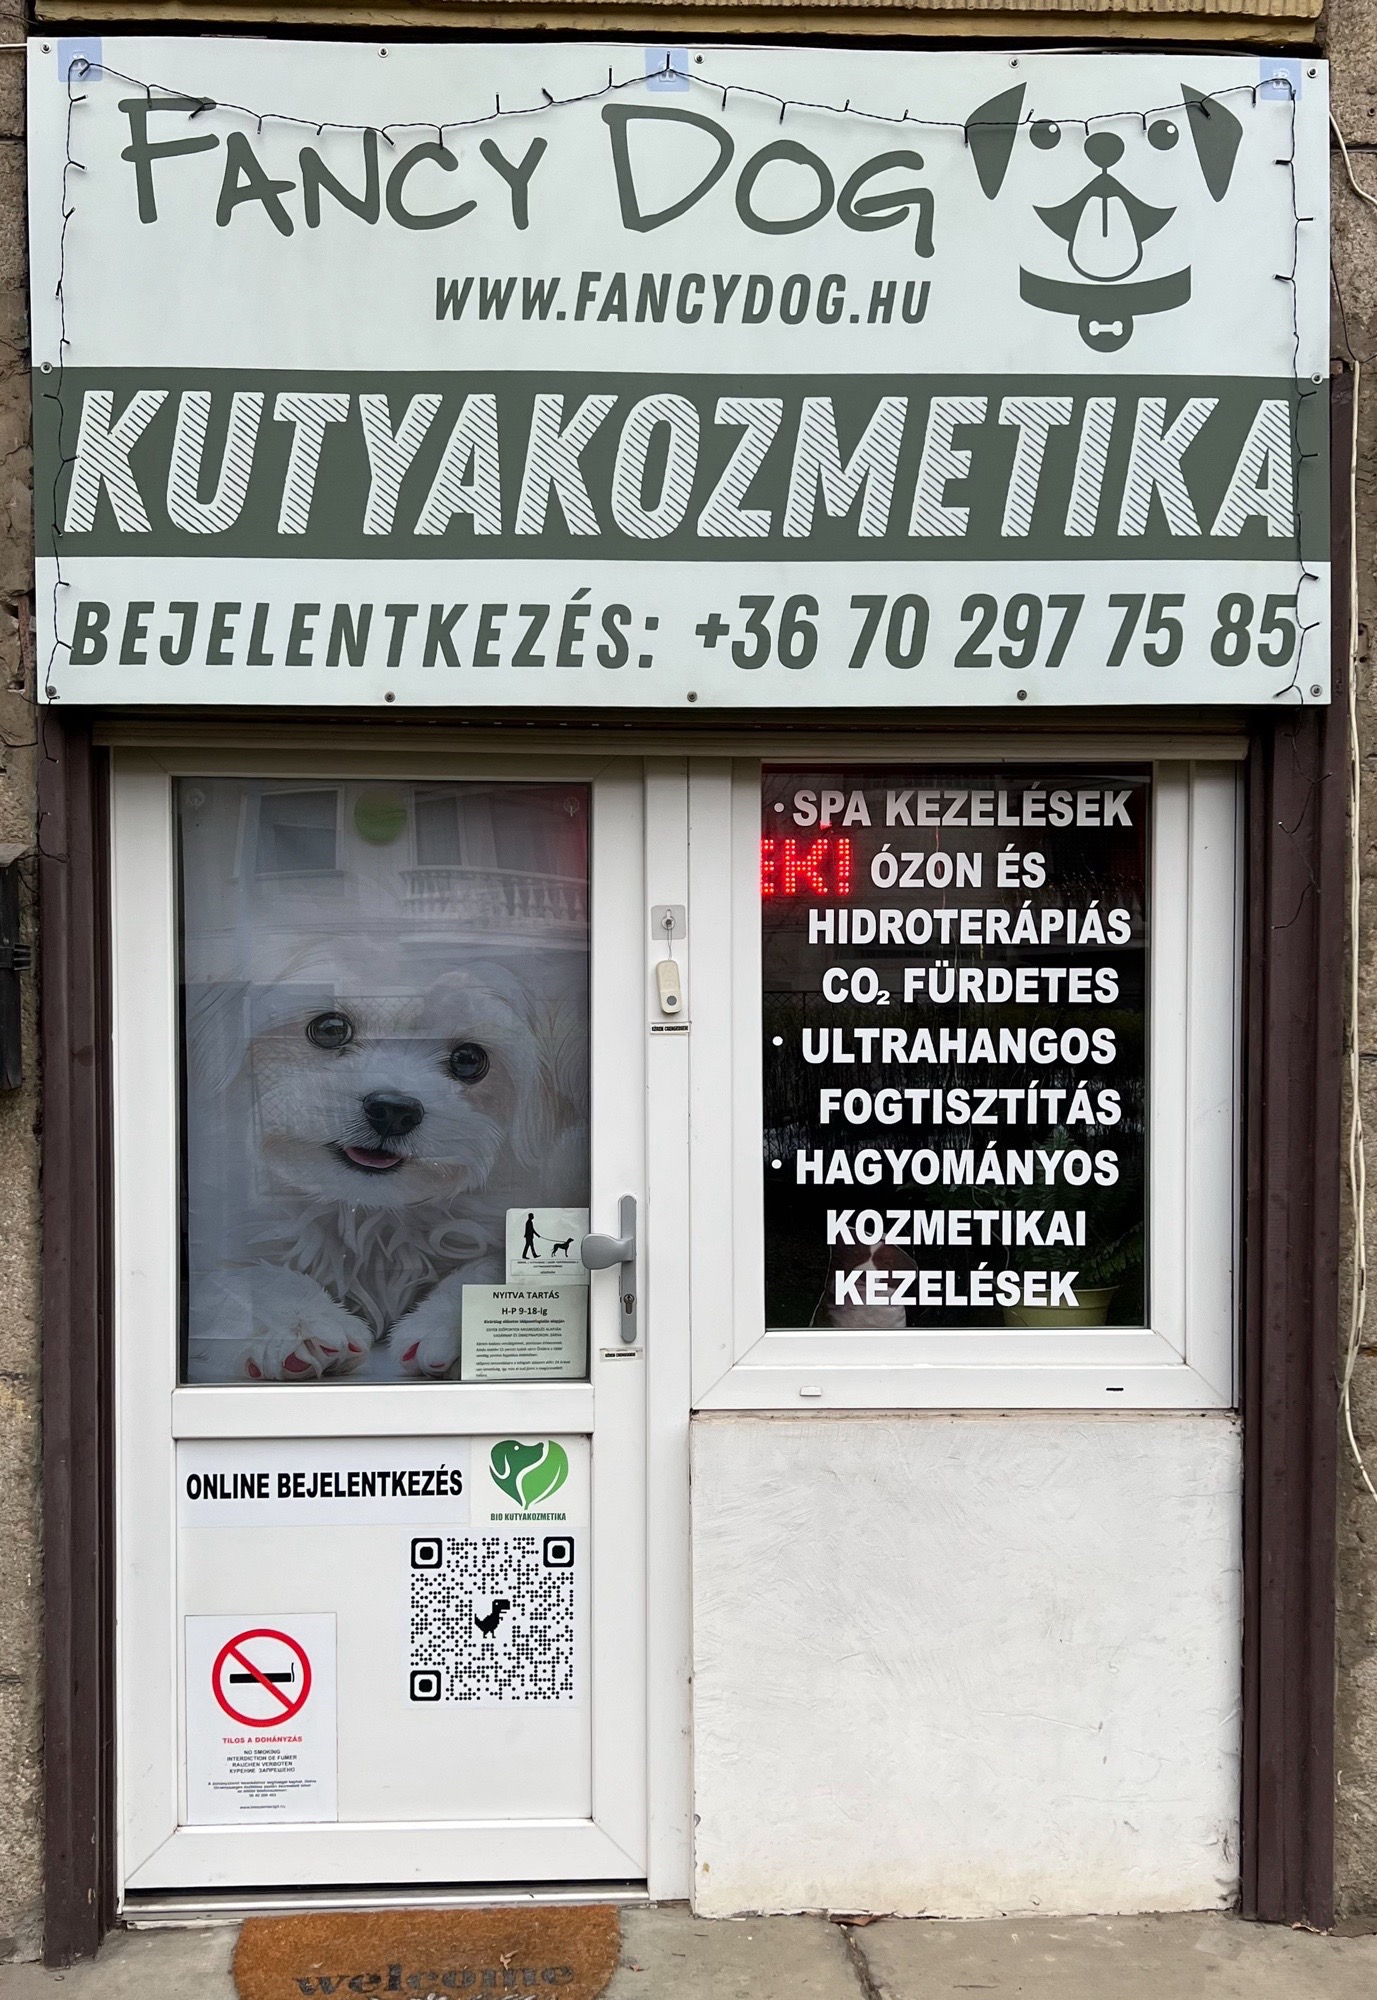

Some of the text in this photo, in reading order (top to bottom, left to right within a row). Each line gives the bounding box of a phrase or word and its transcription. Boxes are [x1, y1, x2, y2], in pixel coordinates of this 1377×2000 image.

[118, 97, 935, 258] FANCY DOG
[435, 271, 931, 325] WWW.FANCYDOG.HU
[63, 389, 1296, 539] KUTYAKOZMETIKA
[71, 587, 1298, 670] BEJELENTKEZÉS: +36 70 297 75 85
[792, 785, 1133, 827] SPA KEZELÉSEK
[870, 843, 1046, 889] ÓZON ÉS
[808, 900, 1132, 945] HIDROTERÁPIÁS
[903, 958, 1120, 1004] FÜRDETES
[802, 1027, 1117, 1065] ULTRAHANGOS
[819, 1079, 1122, 1126] FOGTISZTÍTÁS
[796, 1140, 1119, 1187] HAGYOMÁNYOS
[826, 1209, 1086, 1247] KOZMETIKAI
[493, 1290, 560, 1299] NYITVA TARTÁS
[834, 1263, 1081, 1308] KEZELÉSEK
[501, 1307, 548, 1317] H-P 9-18-ig
[186, 1463, 464, 1501] ONLINE BEJELENTKEZÉS
[490, 1512, 567, 1521] BIO KUTYAKOZMETIKA
[255, 1734, 303, 1743] DOHÁNYZÁS
[294, 1964, 576, 1996] welcome
